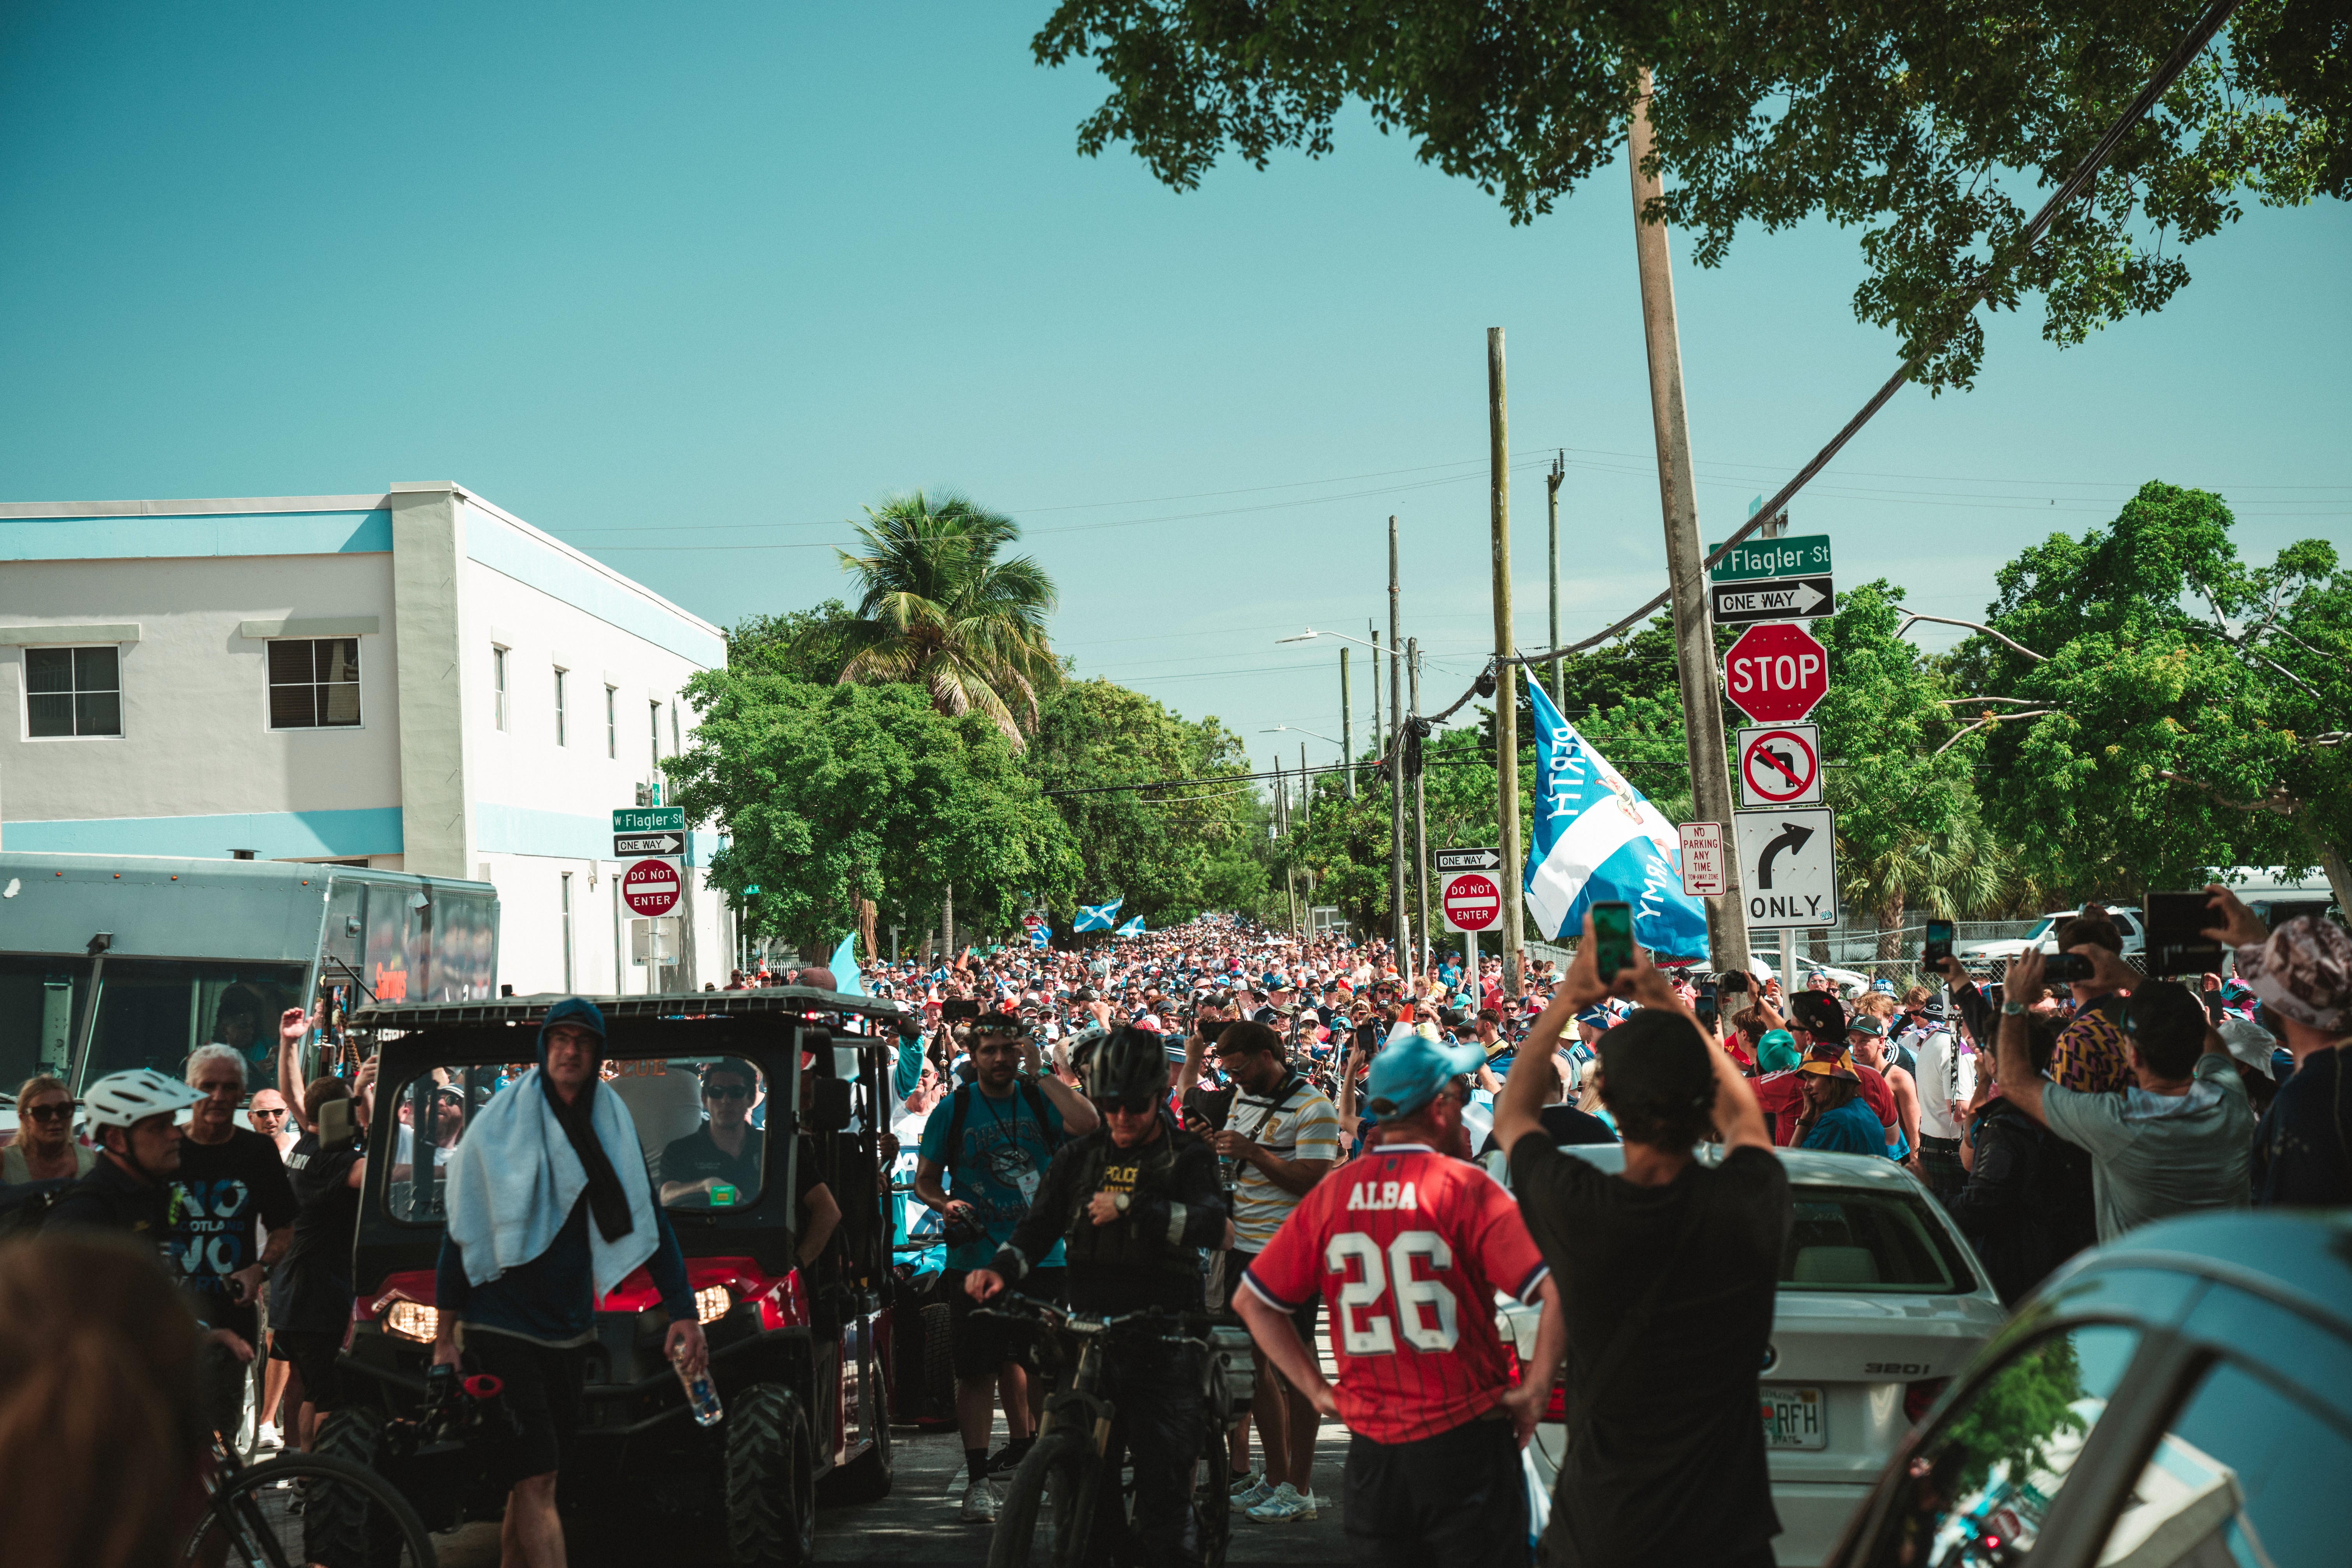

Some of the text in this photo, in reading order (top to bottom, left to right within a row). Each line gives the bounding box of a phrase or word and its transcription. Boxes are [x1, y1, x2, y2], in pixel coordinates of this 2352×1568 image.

[1732, 547, 1804, 576] Flagler
[1813, 545, 1829, 562] St
[1724, 592, 1795, 610] ONE WAY
[1733, 654, 1820, 693] STOP
[614, 813, 682, 830] W Flagler St
[1694, 828, 1705, 837] NO
[620, 840, 662, 850] ONE WAY
[1684, 839, 1718, 849] PARKING
[1442, 856, 1482, 865] ONE WAY
[1694, 851, 1710, 860] ANY
[1694, 862, 1712, 872] TIME
[631, 870, 671, 880] DO NOT
[1452, 886, 1490, 895] DO NOT
[634, 896, 670, 906] ENTER
[1751, 895, 1822, 918] ONLY
[1457, 910, 1489, 920] ENTER
[168, 1179, 249, 1218] NO
[1347, 1182, 1418, 1210] ALBA
[173, 1220, 245, 1232] COTLAND
[170, 1234, 241, 1274] NO
[1325, 1230, 1459, 1355] 26
